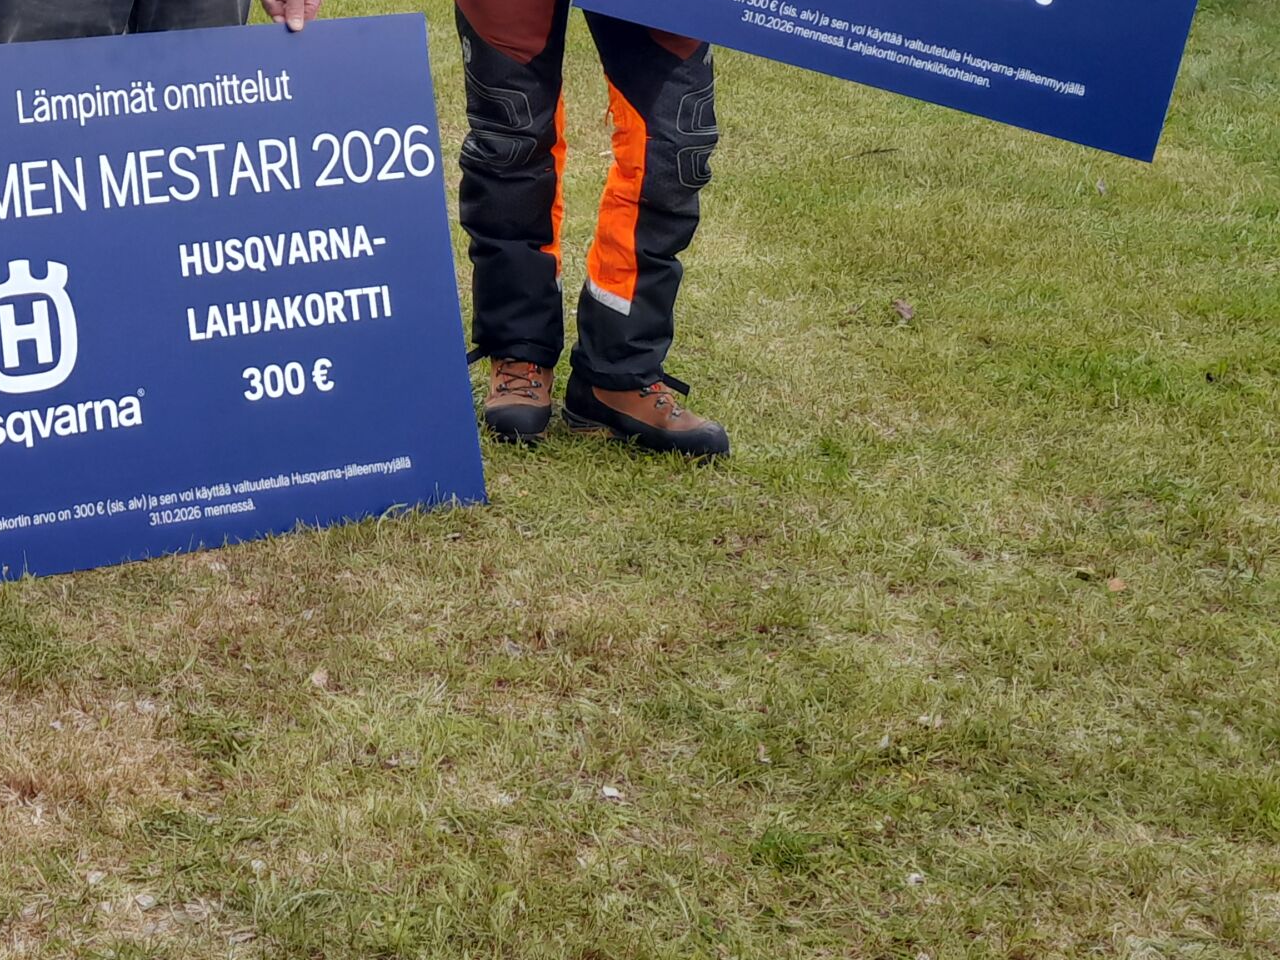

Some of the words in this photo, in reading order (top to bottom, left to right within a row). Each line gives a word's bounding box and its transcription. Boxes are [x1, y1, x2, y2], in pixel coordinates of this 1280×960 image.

[741, 9, 795, 34] 31.10.2026
[793, 26, 845, 48] mennessä.
[846, 38, 897, 62] Lahjakortti
[769, 0, 779, 12] €
[779, 1, 798, 18] (sis.
[799, 9, 820, 25] alv)
[818, 13, 830, 27] ja
[830, 18, 850, 31] sen
[851, 24, 867, 36] voi
[866, 26, 903, 46] käyttää
[904, 38, 962, 62] valtuutetulla
[16, 81, 158, 126] Lämpimät
[163, 69, 293, 111] onnittelut
[99, 136, 301, 209] MESTARI
[312, 124, 435, 187] 2026
[179, 225, 386, 277] HUSQVARNA-
[187, 285, 392, 341] LAHJAKORTTI
[242, 361, 306, 401] 300
[311, 358, 335, 392] €
[32, 512, 57, 526] arvo
[57, 509, 72, 522] on
[73, 502, 96, 519] 300
[96, 501, 105, 515] €
[106, 499, 127, 516] (sis.
[128, 494, 147, 511] alv)
[148, 494, 158, 510] ja
[159, 492, 178, 506] sen
[178, 488, 195, 502] voi
[195, 482, 232, 501] käyttää
[232, 474, 291, 494] valtuutetulla
[149, 505, 202, 526] 31.10.2026
[204, 498, 256, 517] mennessä.
